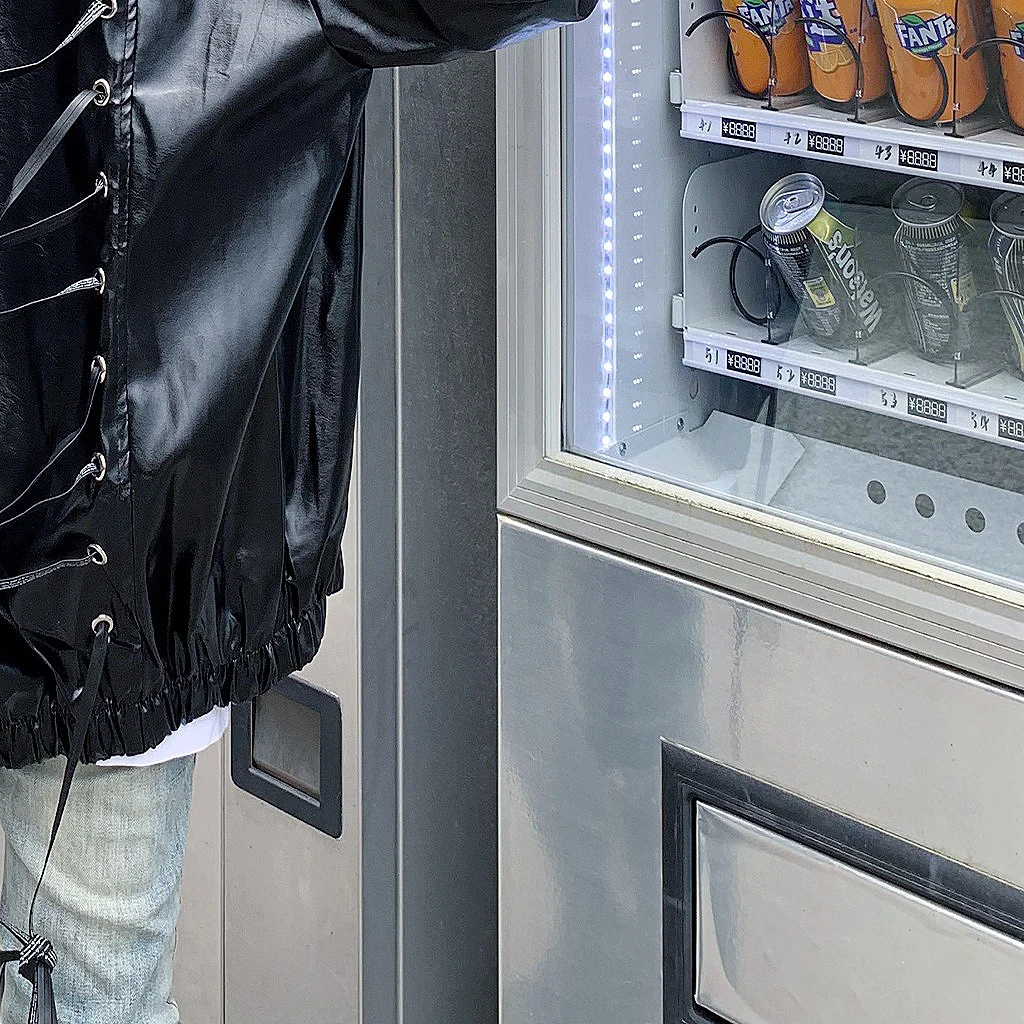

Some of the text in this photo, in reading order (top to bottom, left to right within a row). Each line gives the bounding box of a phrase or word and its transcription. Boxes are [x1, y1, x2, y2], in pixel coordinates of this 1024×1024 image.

[896, 15, 956, 48] FANTA
[875, 145, 892, 161] 43
[977, 161, 998, 177] 44
[827, 230, 883, 334] Watson's
[705, 347, 719, 365] 51
